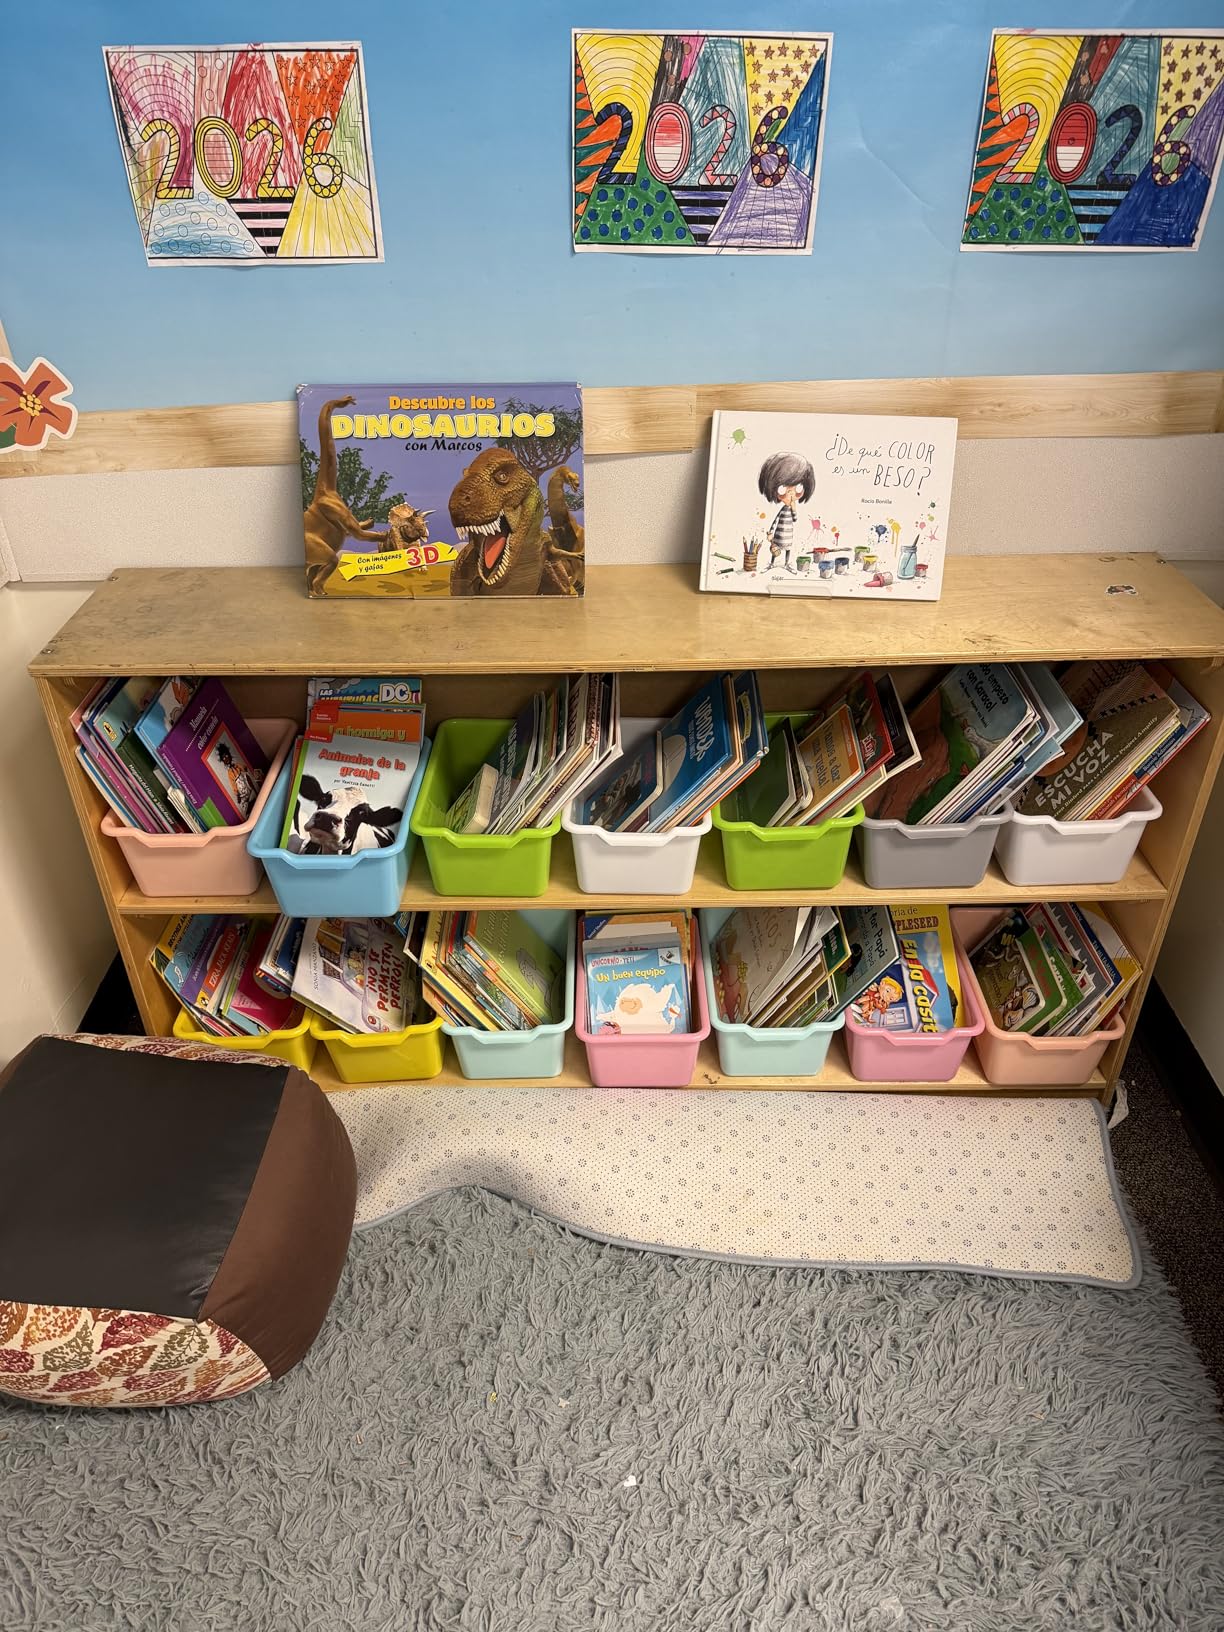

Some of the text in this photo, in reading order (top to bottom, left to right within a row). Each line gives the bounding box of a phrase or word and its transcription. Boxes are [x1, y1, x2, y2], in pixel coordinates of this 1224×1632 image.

[595, 101, 788, 188] 2026
[995, 102, 1197, 187] 2026
[139, 115, 343, 199] 2026
[389, 395, 495, 410] Descubre los
[331, 412, 555, 439] DINOSAURIOS
[405, 439, 482, 451] con Marcos
[825, 433, 935, 466] ¿De qué COLOR
[832, 463, 932, 496] es un BESO?
[357, 553, 402, 564] Con imágenes
[405, 544, 440, 567] 3D
[364, 563, 384, 573] gafas
[380, 683, 410, 702] DC
[975, 680, 998, 713] Caracol
[346, 726, 395, 739] hormiga
[397, 729, 407, 740] y
[318, 748, 406, 771] Animales de la
[1034, 731, 1114, 808] ESCUCHA
[339, 766, 380, 781] granja
[1050, 784, 1073, 810] MI
[1072, 747, 1111, 785] VOZ
[907, 906, 918, 915] de
[368, 948, 380, 965] SE
[376, 942, 394, 1012] PERMITEN
[596, 967, 666, 983] Un buen equipo
[900, 939, 939, 1033] En la casit
